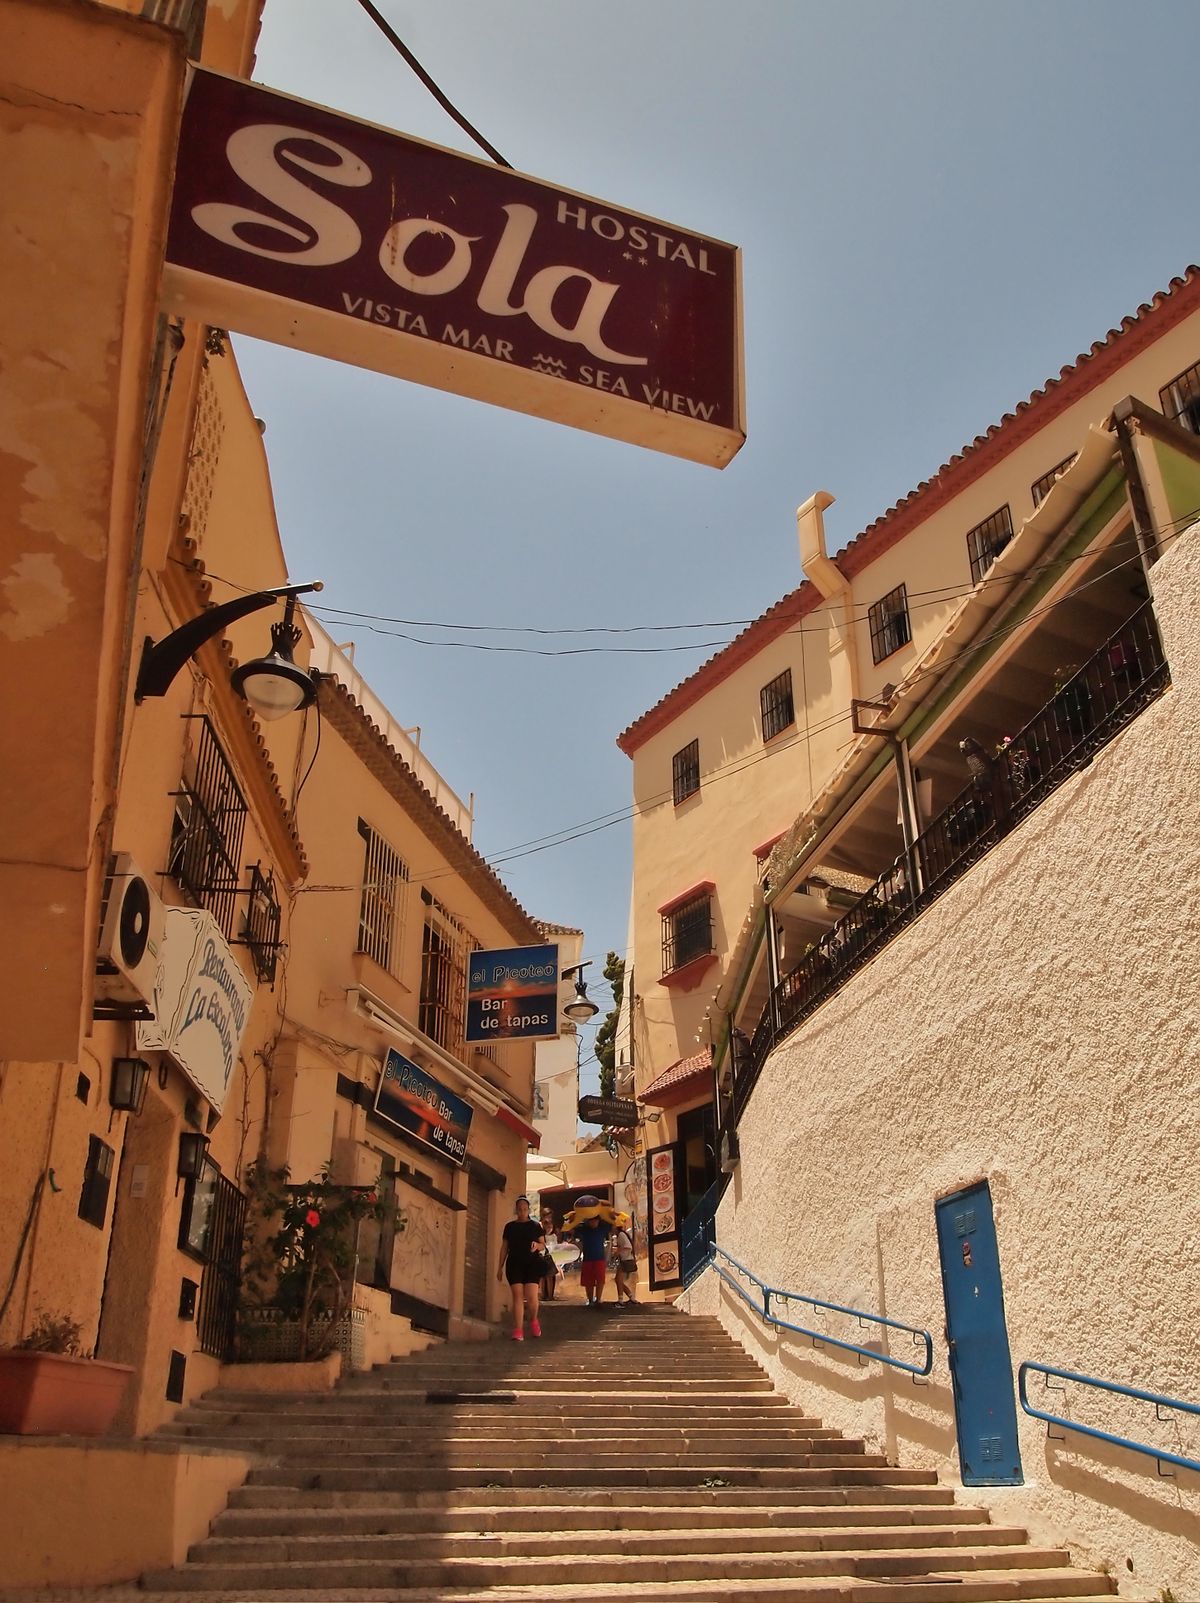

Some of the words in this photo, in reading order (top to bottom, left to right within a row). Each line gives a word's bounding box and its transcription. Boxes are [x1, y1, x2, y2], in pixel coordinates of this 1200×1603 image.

[190, 123, 649, 366] Sola
[556, 200, 718, 276] HOSTAL
[341, 292, 430, 338] VISTA
[441, 322, 515, 363] MAR
[578, 363, 631, 398] SEA
[641, 382, 715, 422] VIEW
[199, 938, 246, 1041] Restaurante
[471, 968, 486, 984] el
[492, 964, 555, 983] Picoteo
[481, 999, 508, 1012] Bar
[178, 987, 207, 1036] La
[206, 992, 233, 1090] Escalera
[480, 1015, 499, 1030] de
[507, 1013, 549, 1030] tapas
[385, 1058, 398, 1080] el
[399, 1064, 438, 1109] Picoteo
[439, 1101, 454, 1122] Bar
[433, 1124, 444, 1143] de
[445, 1130, 465, 1157] tapas
